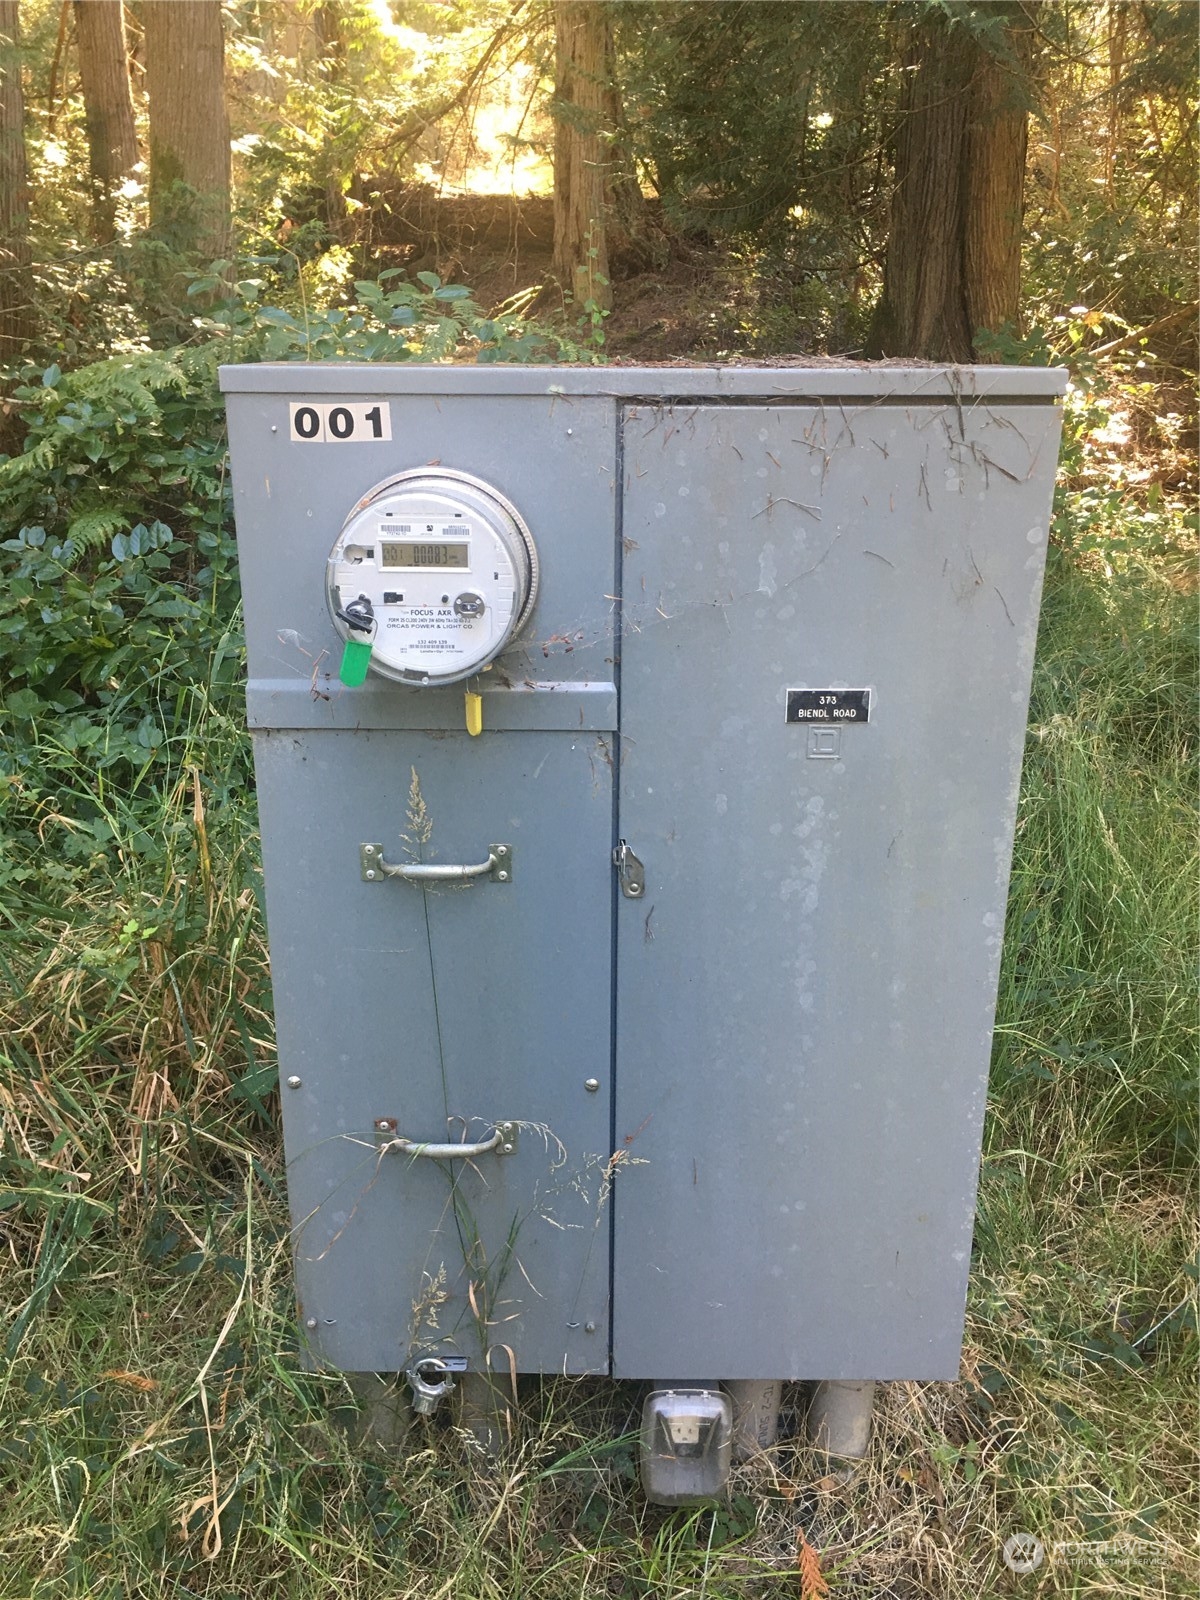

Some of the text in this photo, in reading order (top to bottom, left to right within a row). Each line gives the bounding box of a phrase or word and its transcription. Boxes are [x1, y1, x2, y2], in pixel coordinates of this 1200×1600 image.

[294, 406, 383, 439] 001
[413, 545, 448, 564] 00083
[818, 695, 837, 705] 373
[798, 708, 857, 718] BIENDL ROAD
